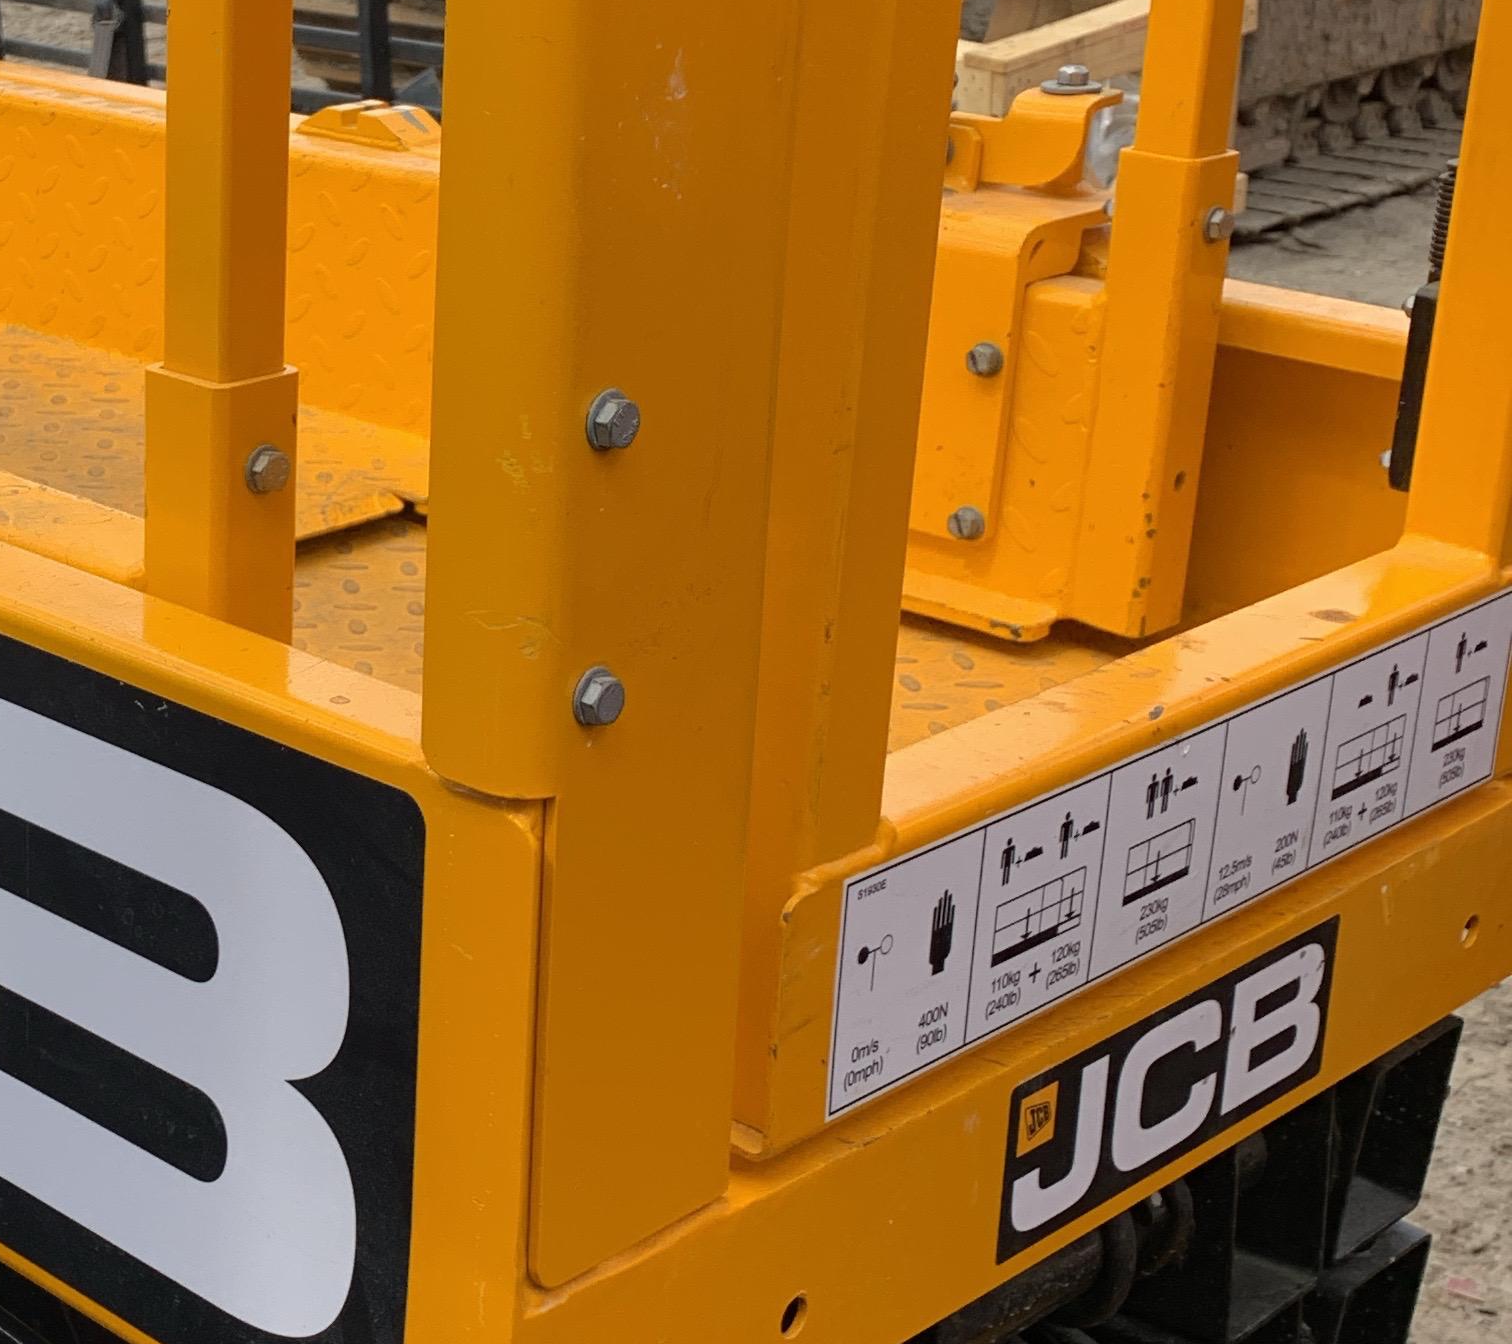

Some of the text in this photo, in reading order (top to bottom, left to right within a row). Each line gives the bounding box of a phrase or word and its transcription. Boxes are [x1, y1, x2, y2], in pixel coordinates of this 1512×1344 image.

[1139, 897, 1170, 922] 230kg
[991, 970, 1022, 994] 110kg
[1051, 940, 1081, 965] 120kg
[984, 957, 1081, 1021] (240lb) (265lb)
[918, 1002, 949, 1029] 400N
[916, 1023, 948, 1056] (90lb)
[1010, 942, 1326, 1233] JCB
